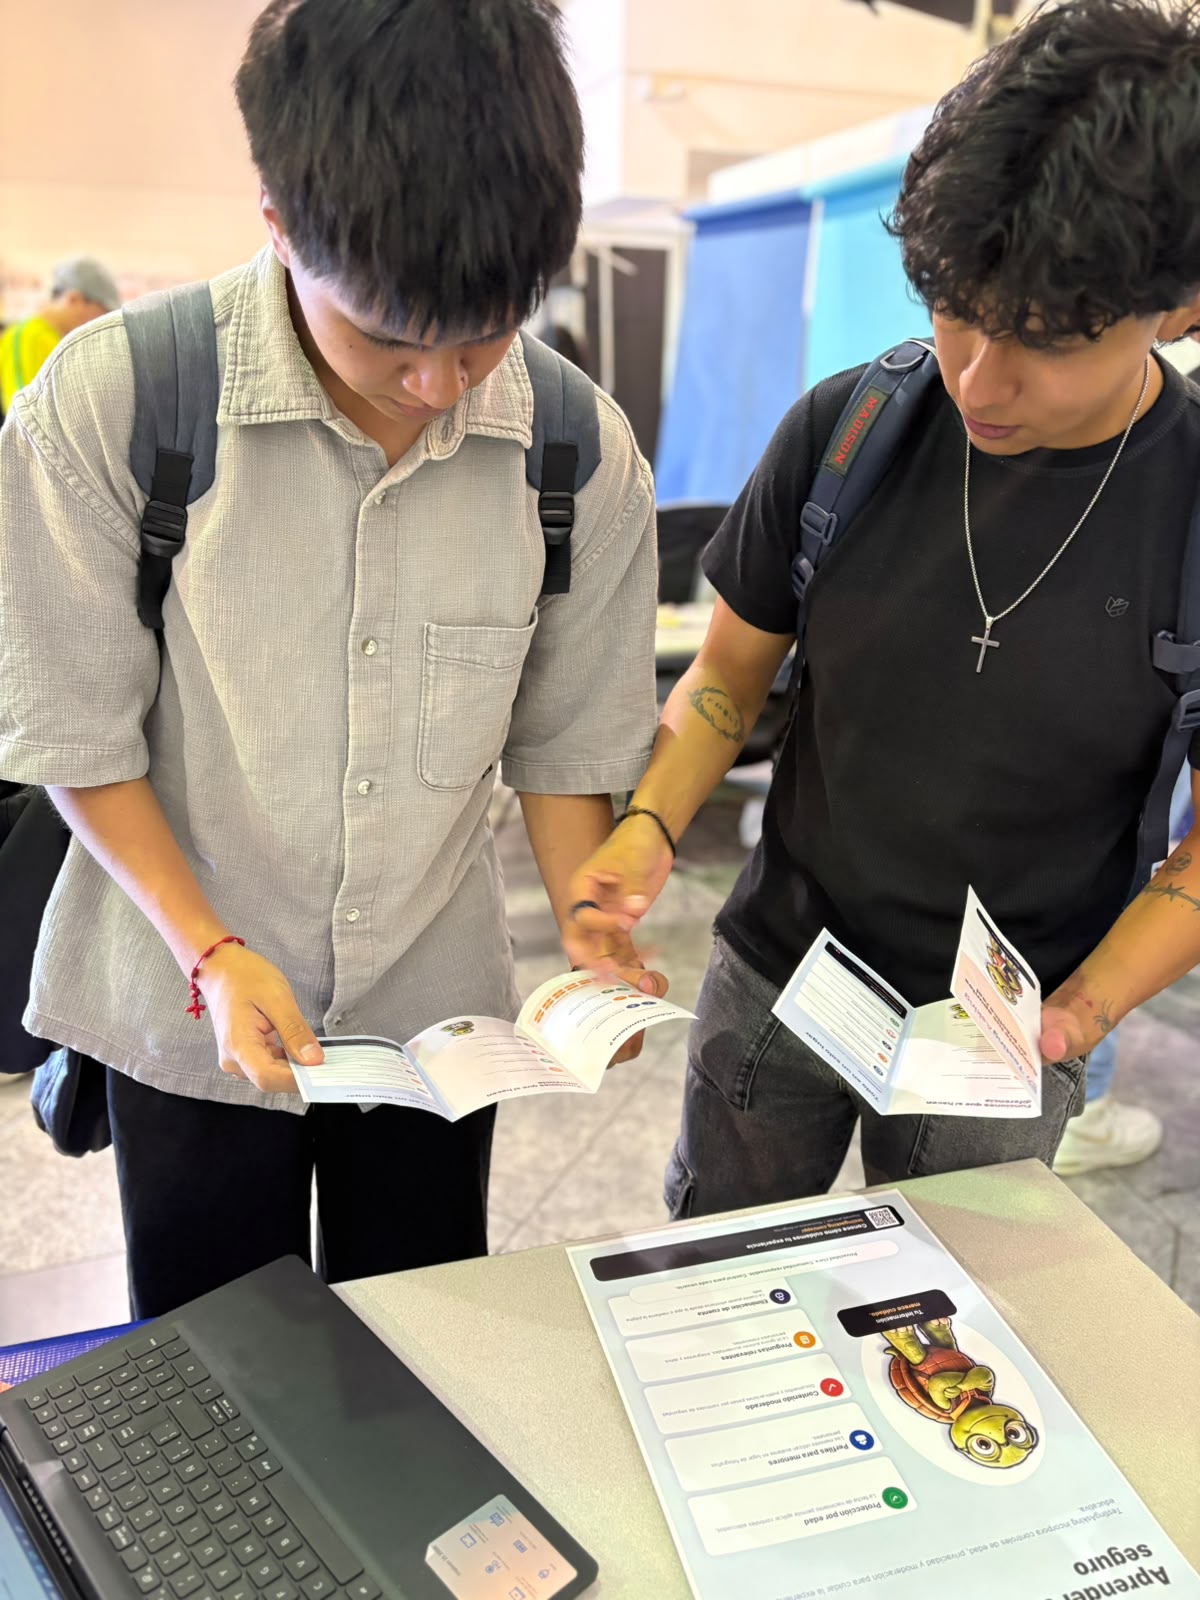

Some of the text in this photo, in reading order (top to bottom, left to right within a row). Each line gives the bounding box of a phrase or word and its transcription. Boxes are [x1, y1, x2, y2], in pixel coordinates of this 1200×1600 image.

[834, 396, 878, 465] MADISON
[823, 1227, 841, 1236] cómo
[842, 1223, 867, 1232] Conoce
[792, 1231, 823, 1241] cuidamos
[745, 1237, 783, 1250] experiencia
[730, 1298, 768, 1311] Eliminación
[896, 1301, 920, 1311] merece
[696, 1308, 719, 1316] cuenta
[874, 1311, 913, 1324] información
[719, 1341, 792, 1361] Preguntas relevantes
[744, 1390, 819, 1411] Contenido moderado
[767, 1443, 848, 1465] Perfiles para menores
[803, 1501, 881, 1525] Protección por edad
[1034, 1520, 1070, 1536] incorpora
[999, 1530, 1035, 1546] controles
[988, 1540, 999, 1550] de
[1073, 1544, 1153, 1576] seguro
[851, 1574, 870, 1585] para
